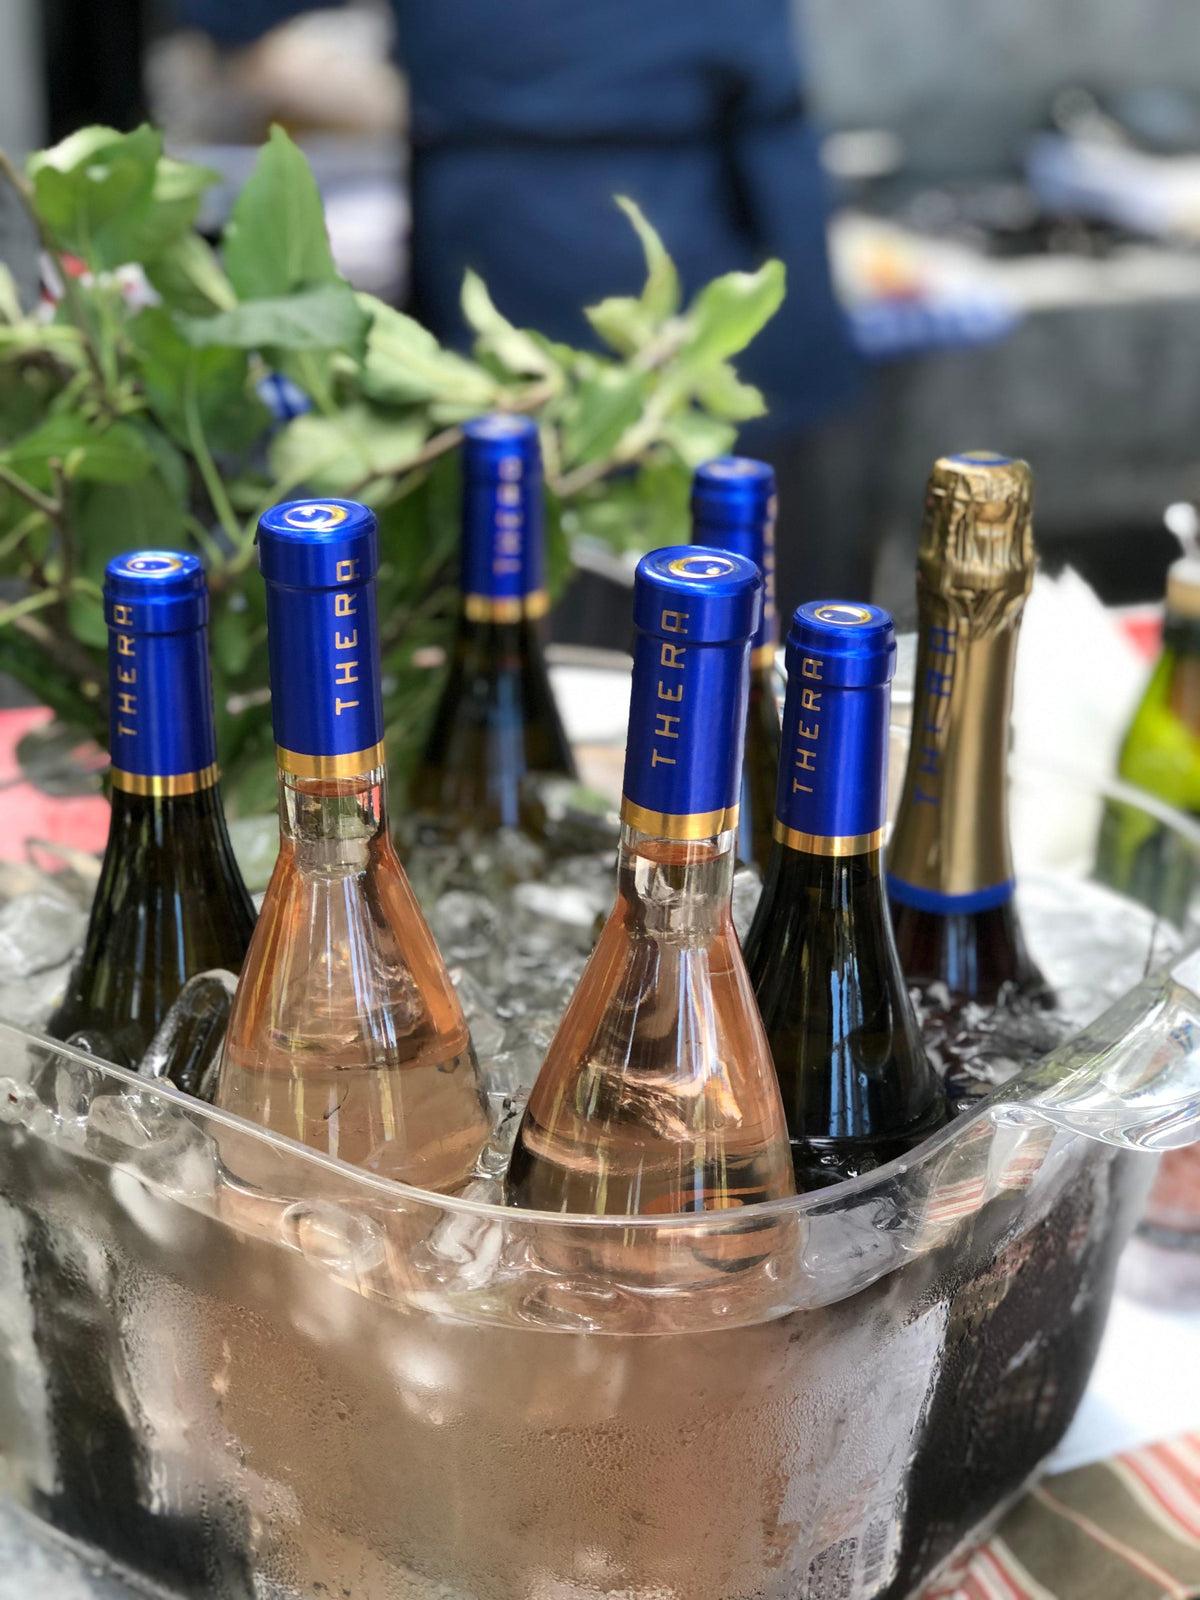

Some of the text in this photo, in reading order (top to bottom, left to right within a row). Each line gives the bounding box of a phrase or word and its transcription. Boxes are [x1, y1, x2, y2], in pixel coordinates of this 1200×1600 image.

[114, 604, 137, 738] THERA
[334, 558, 361, 716] THERA
[651, 609, 690, 768] THERA
[792, 657, 824, 794] THERA
